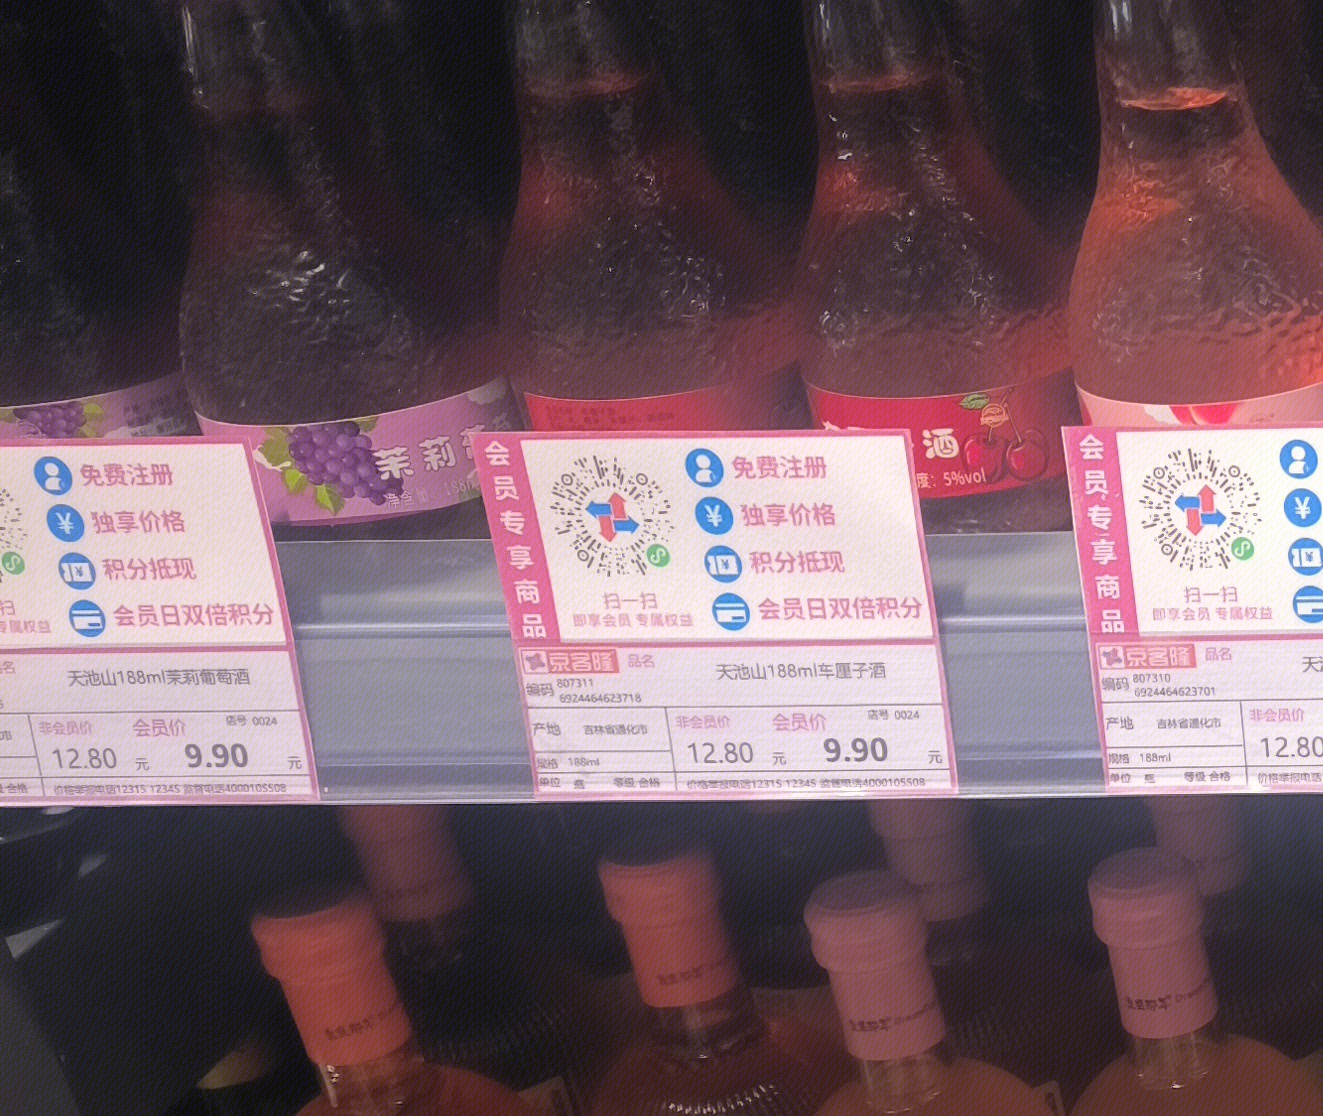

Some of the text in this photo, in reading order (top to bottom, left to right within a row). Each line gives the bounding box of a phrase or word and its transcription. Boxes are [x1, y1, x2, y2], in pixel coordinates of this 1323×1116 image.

[80, 464, 174, 487] 免费注册
[731, 456, 828, 481] 免费注册
[92, 510, 186, 534] 独享价格
[740, 503, 836, 527] 独享价格
[483, 440, 547, 640] 会员专享商品
[1079, 434, 1125, 633] 会员专享商品
[102, 558, 196, 582] 积分抵现
[750, 551, 846, 574] 积分抵现
[113, 604, 274, 628] 会员日双倍积分
[758, 598, 922, 621] 会员日双倍积分
[67, 668, 250, 686] 天池山188ml茉莉葡萄酒
[716, 662, 887, 681] 天池山188ml车厘子酒
[52, 743, 249, 770] 12.80 9.90
[688, 737, 889, 764] 12.80 9.90
